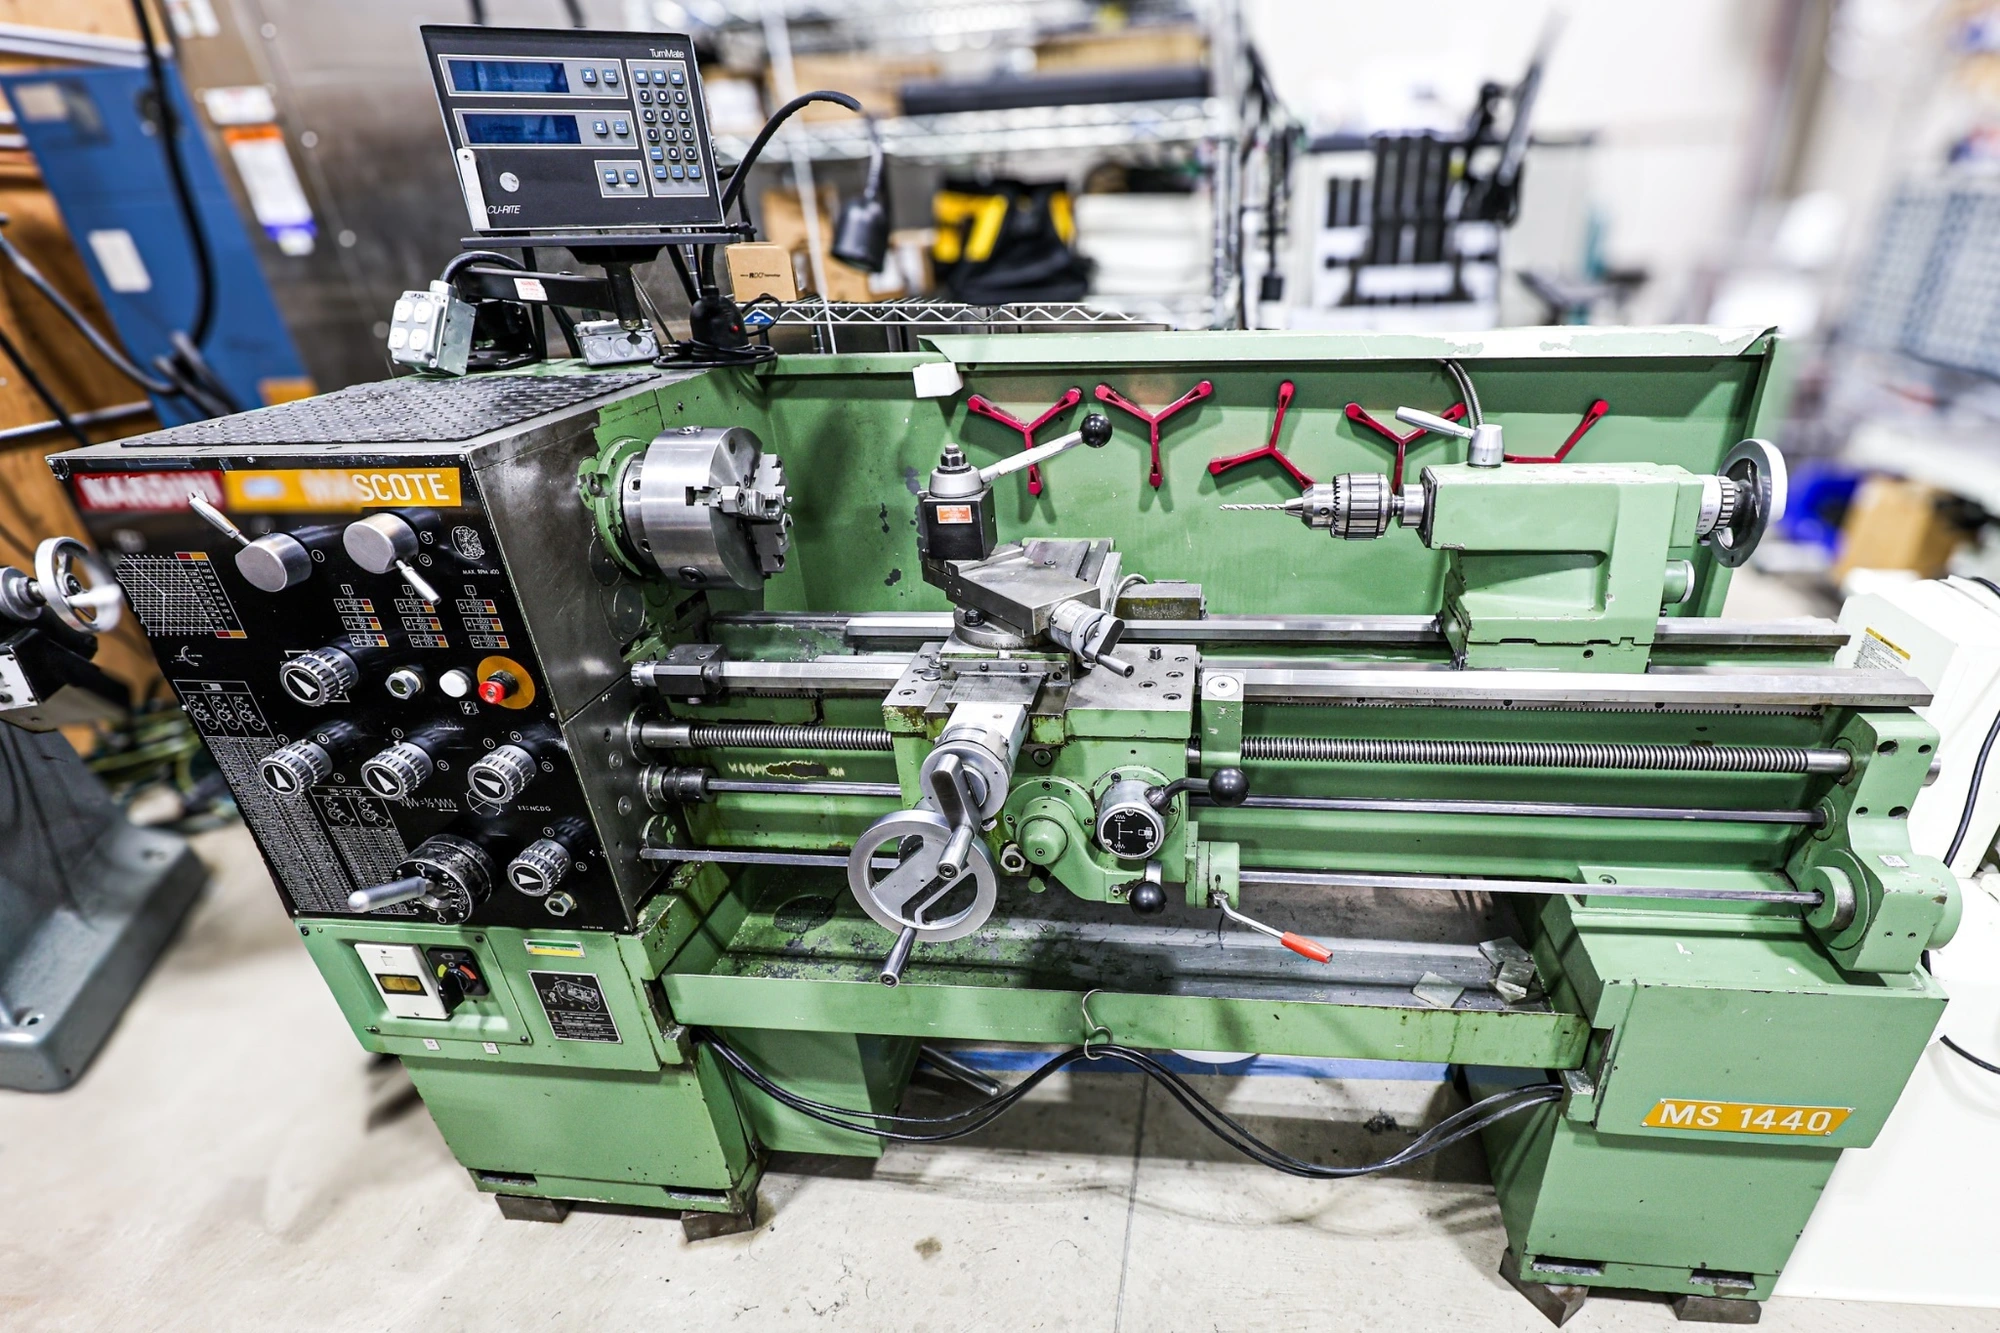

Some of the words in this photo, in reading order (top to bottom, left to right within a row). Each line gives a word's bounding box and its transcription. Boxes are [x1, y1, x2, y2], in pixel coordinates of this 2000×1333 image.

[649, 48, 684, 59] TurnMate
[585, 71, 592, 79] X
[487, 204, 521, 215] CU-RITE
[1659, 1103, 1723, 1127] MS
[1740, 1107, 1832, 1132] 1440
